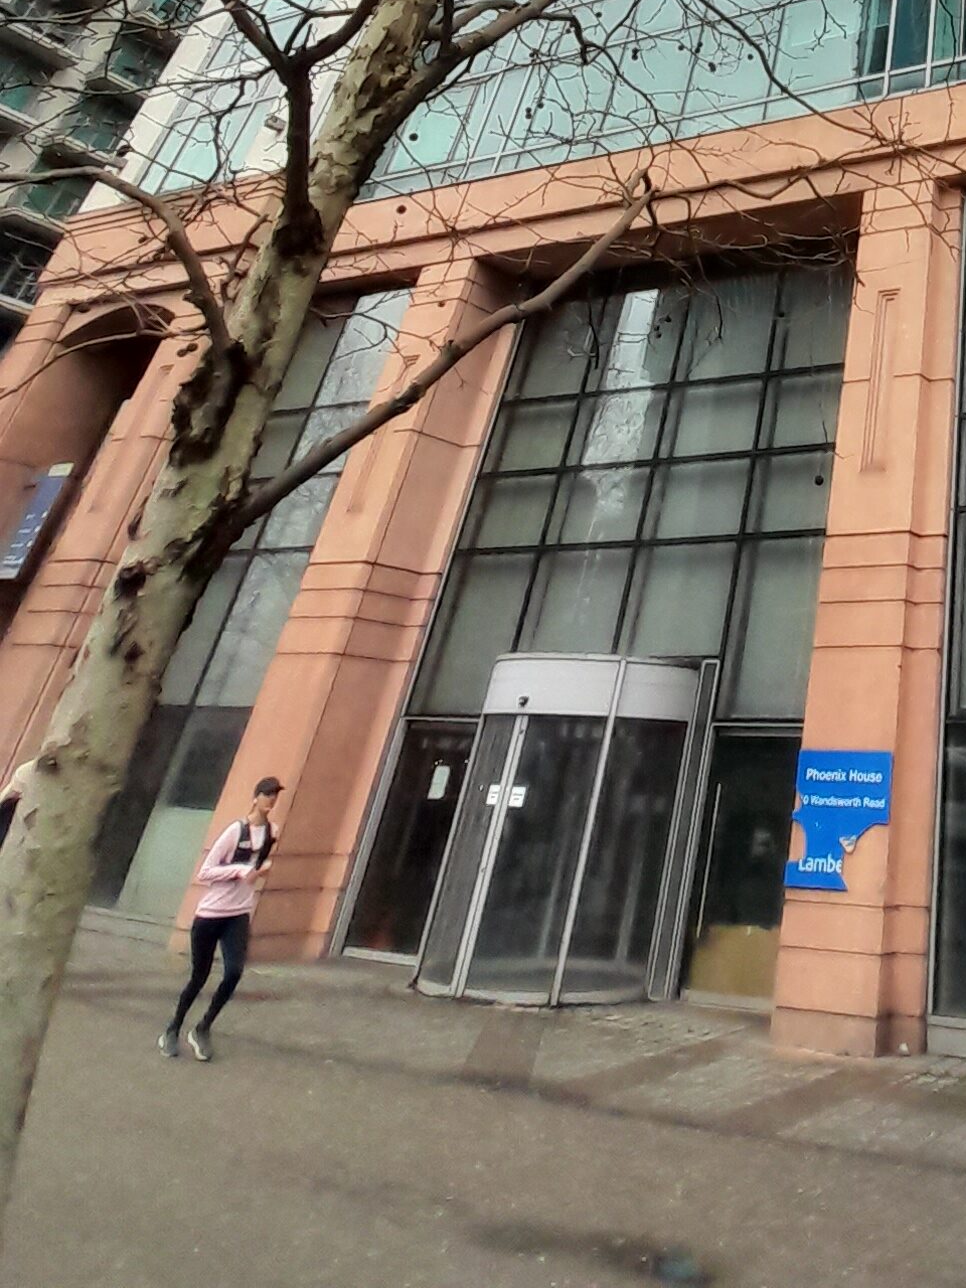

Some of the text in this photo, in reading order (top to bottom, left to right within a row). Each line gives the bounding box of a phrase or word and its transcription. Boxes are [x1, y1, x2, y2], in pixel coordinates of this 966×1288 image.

[806, 768, 883, 783] Phoenix House
[810, 795, 862, 807] Wandsworth
[863, 797, 885, 808] Road
